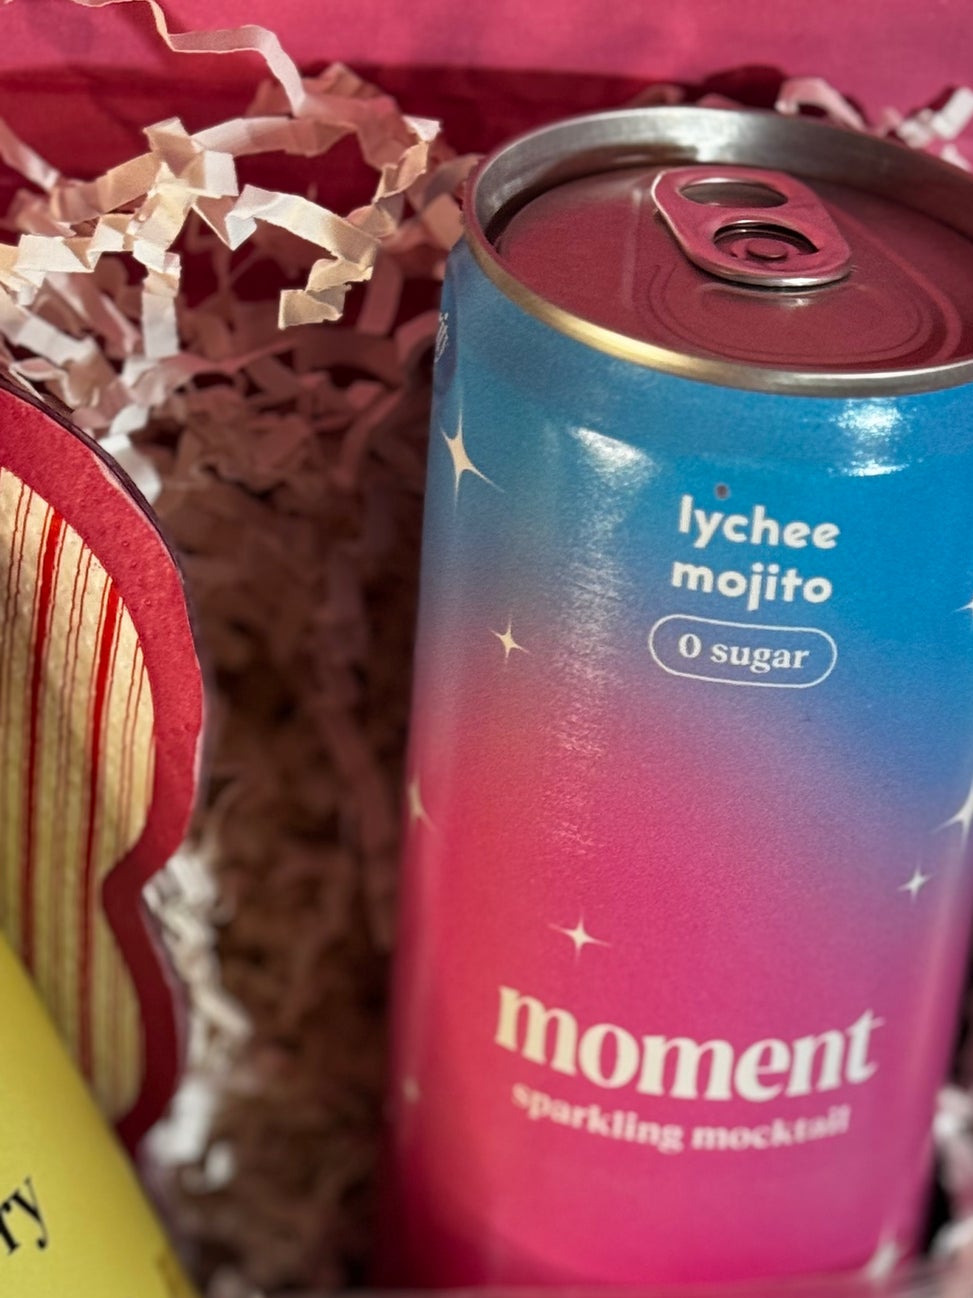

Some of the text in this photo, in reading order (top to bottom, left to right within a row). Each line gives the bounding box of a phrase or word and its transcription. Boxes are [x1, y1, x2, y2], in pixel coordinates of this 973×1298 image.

[678, 495, 840, 549] lychee
[671, 560, 833, 611] mojito
[677, 632, 810, 675] 0 sugar
[494, 984, 885, 1102] moment
[511, 1081, 852, 1156] sparkling mocktail
